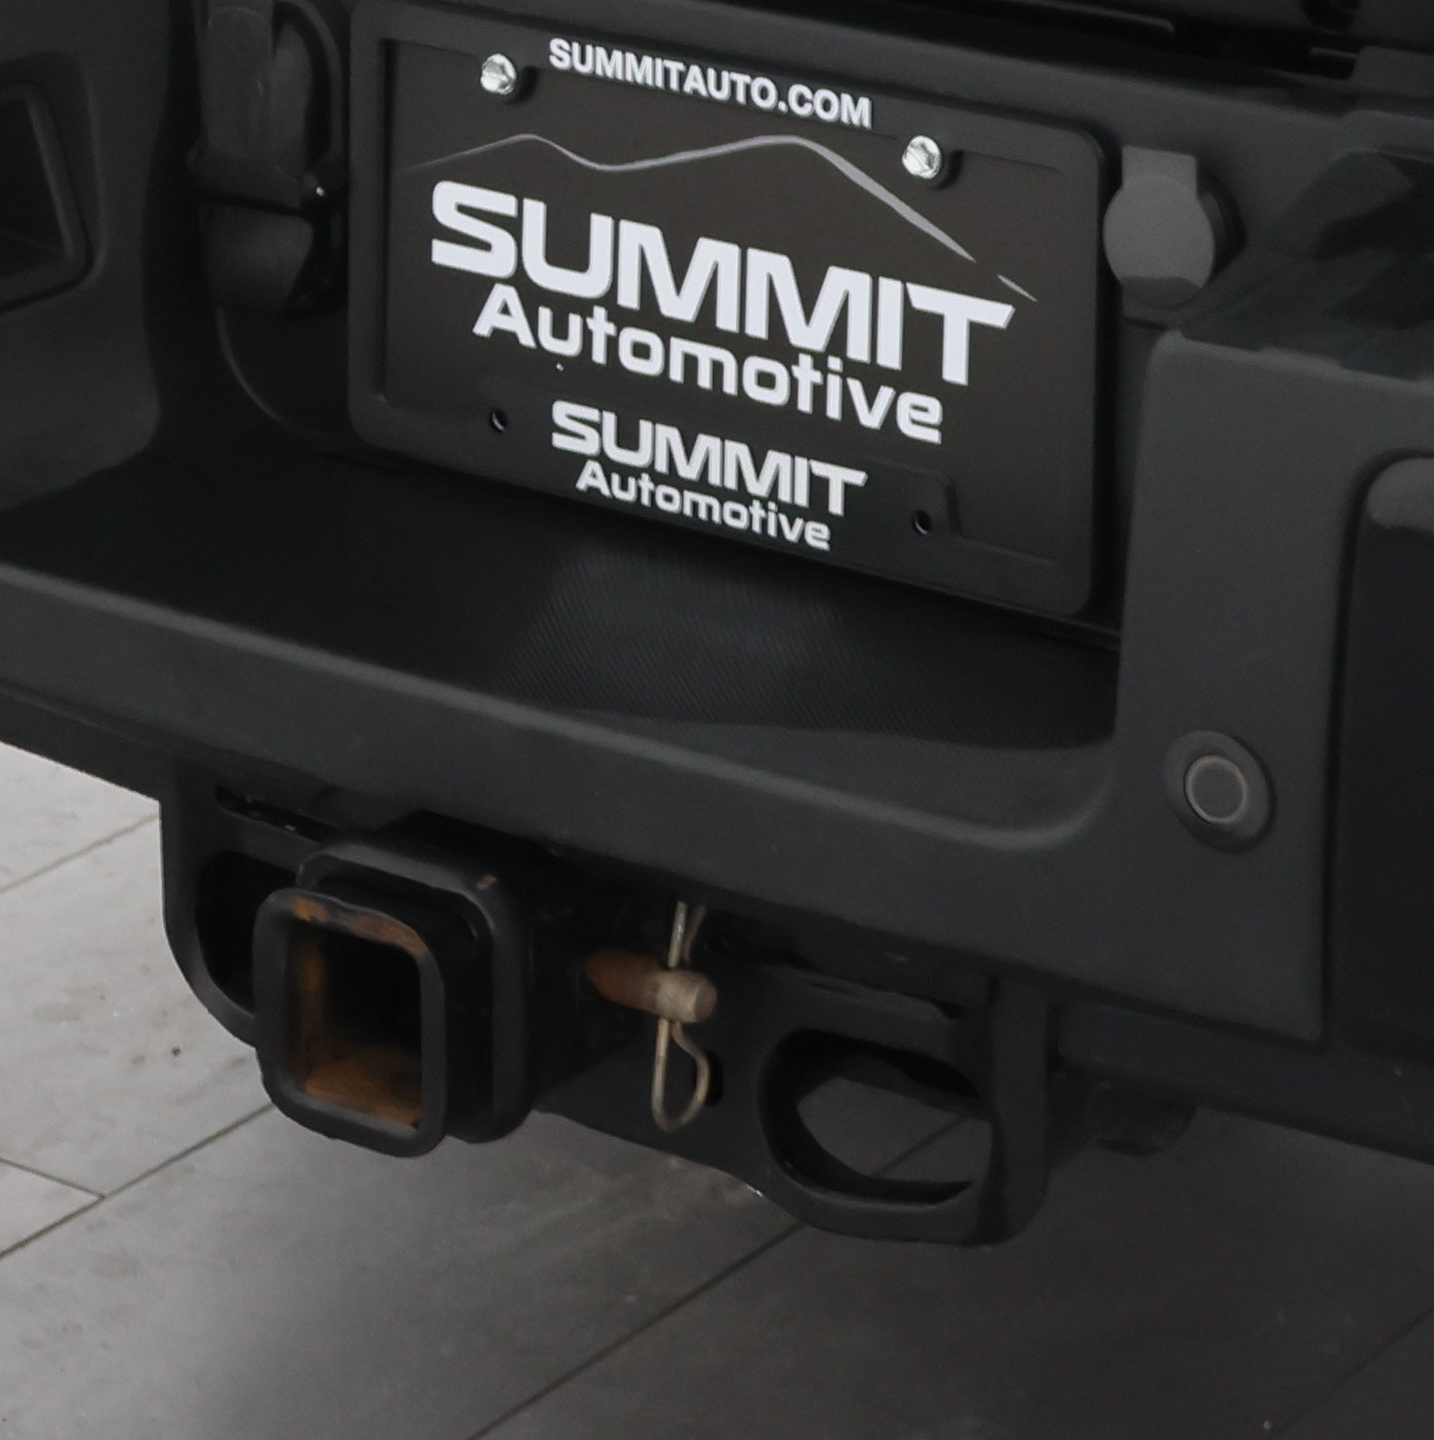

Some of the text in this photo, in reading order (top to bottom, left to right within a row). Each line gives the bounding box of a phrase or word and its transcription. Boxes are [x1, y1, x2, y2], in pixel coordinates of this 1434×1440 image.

[548, 36, 873, 130] SUMMITAUTO.COM
[430, 179, 1016, 386] SUMMIT
[471, 283, 944, 445] Automotive
[550, 399, 868, 516] SUMMIT
[575, 459, 831, 551] Automotive
